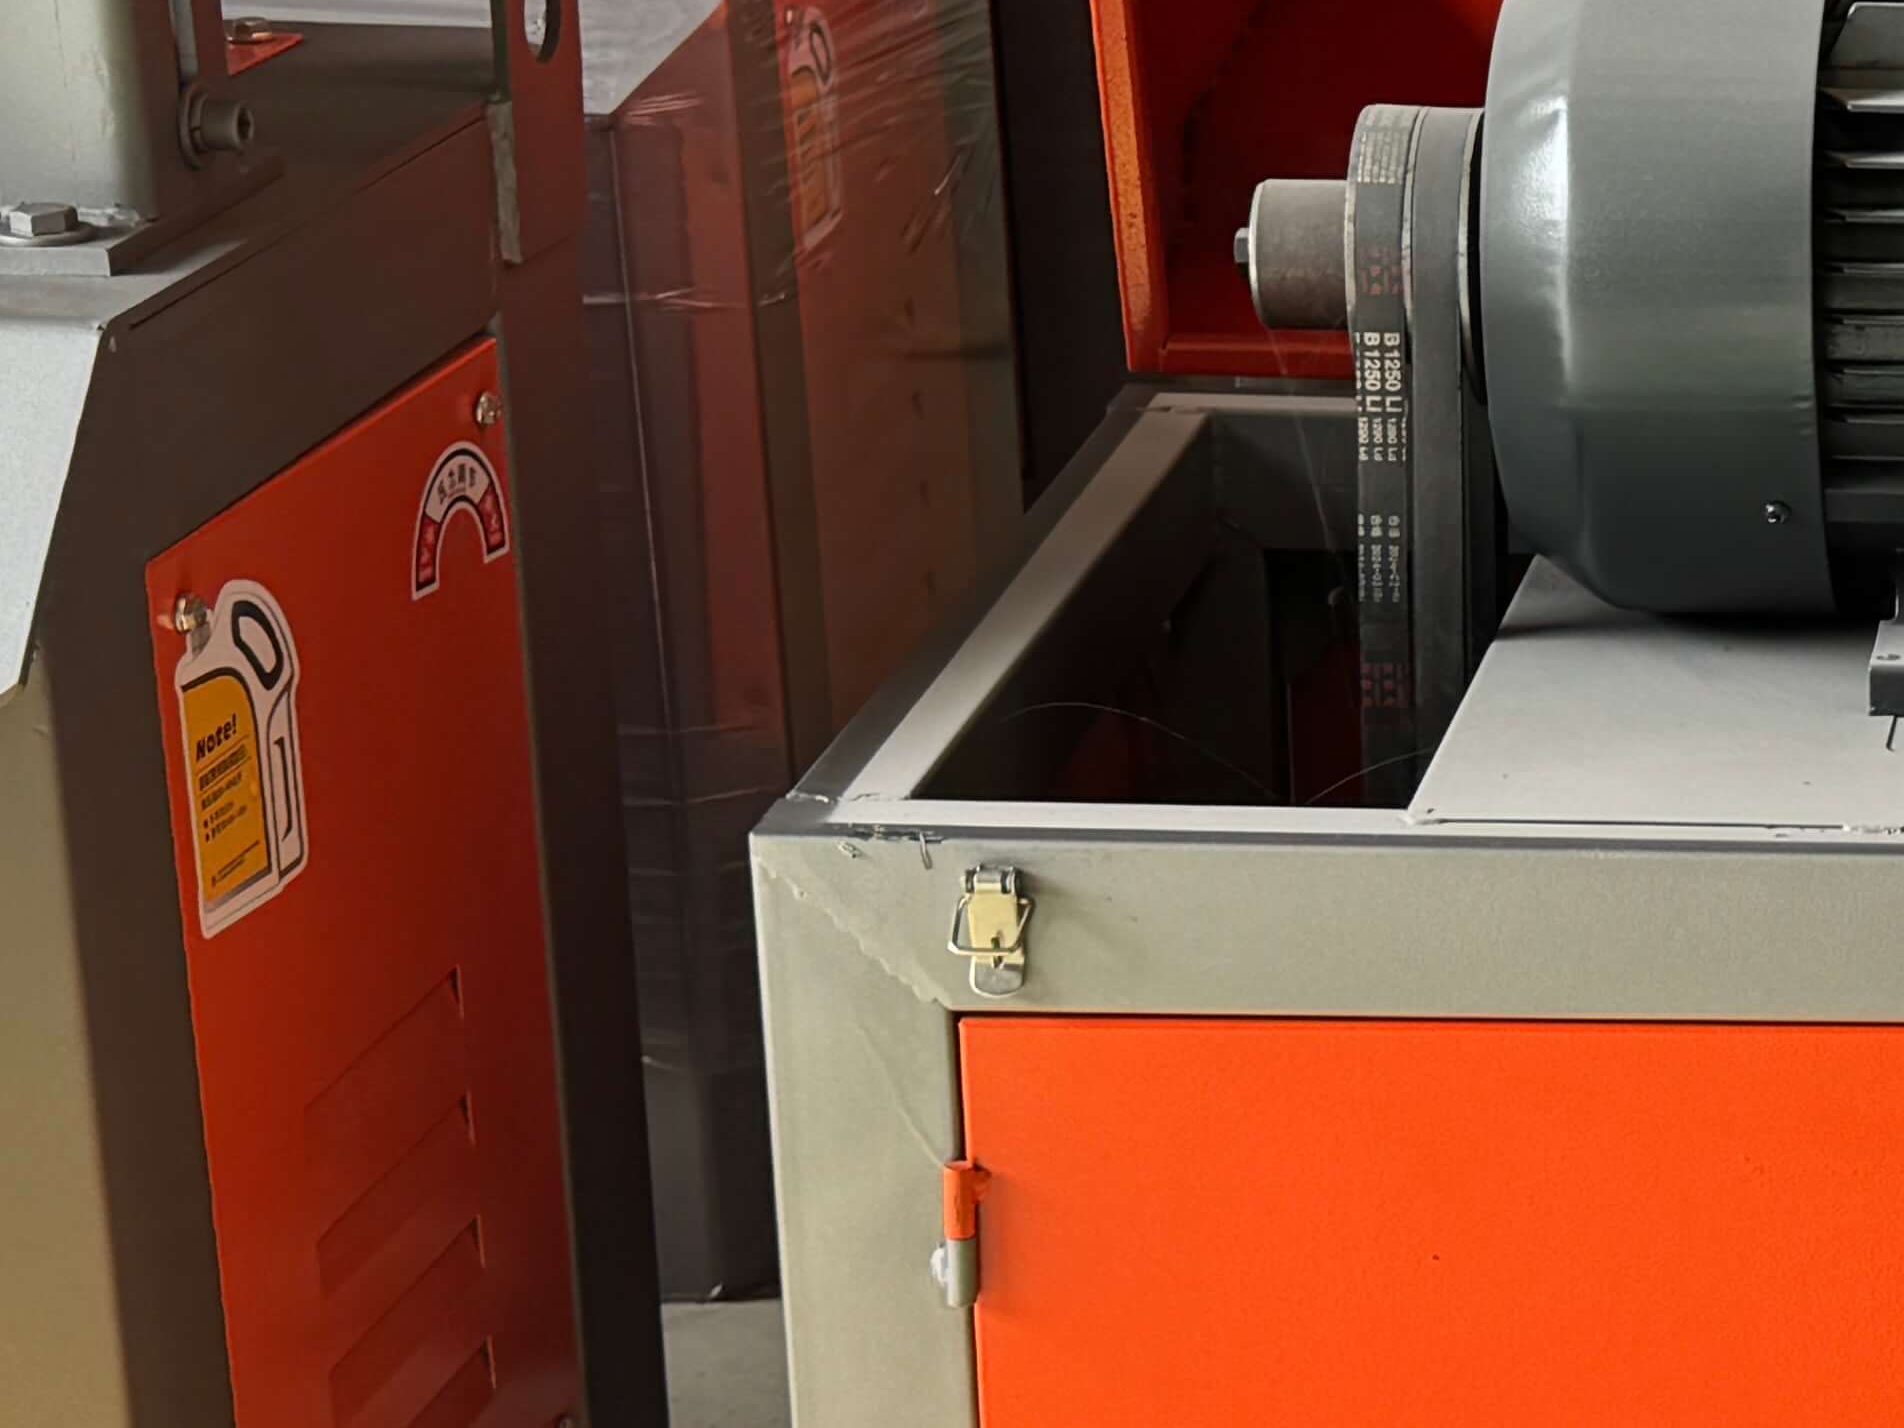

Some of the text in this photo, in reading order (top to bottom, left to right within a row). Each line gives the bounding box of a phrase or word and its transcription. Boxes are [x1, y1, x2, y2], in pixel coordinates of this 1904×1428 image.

[1363, 332, 1380, 346] B
[1384, 332, 1400, 346] B
[1364, 349, 1382, 391] 1250
[1384, 349, 1402, 392] 1250
[196, 713, 238, 762] Note!
